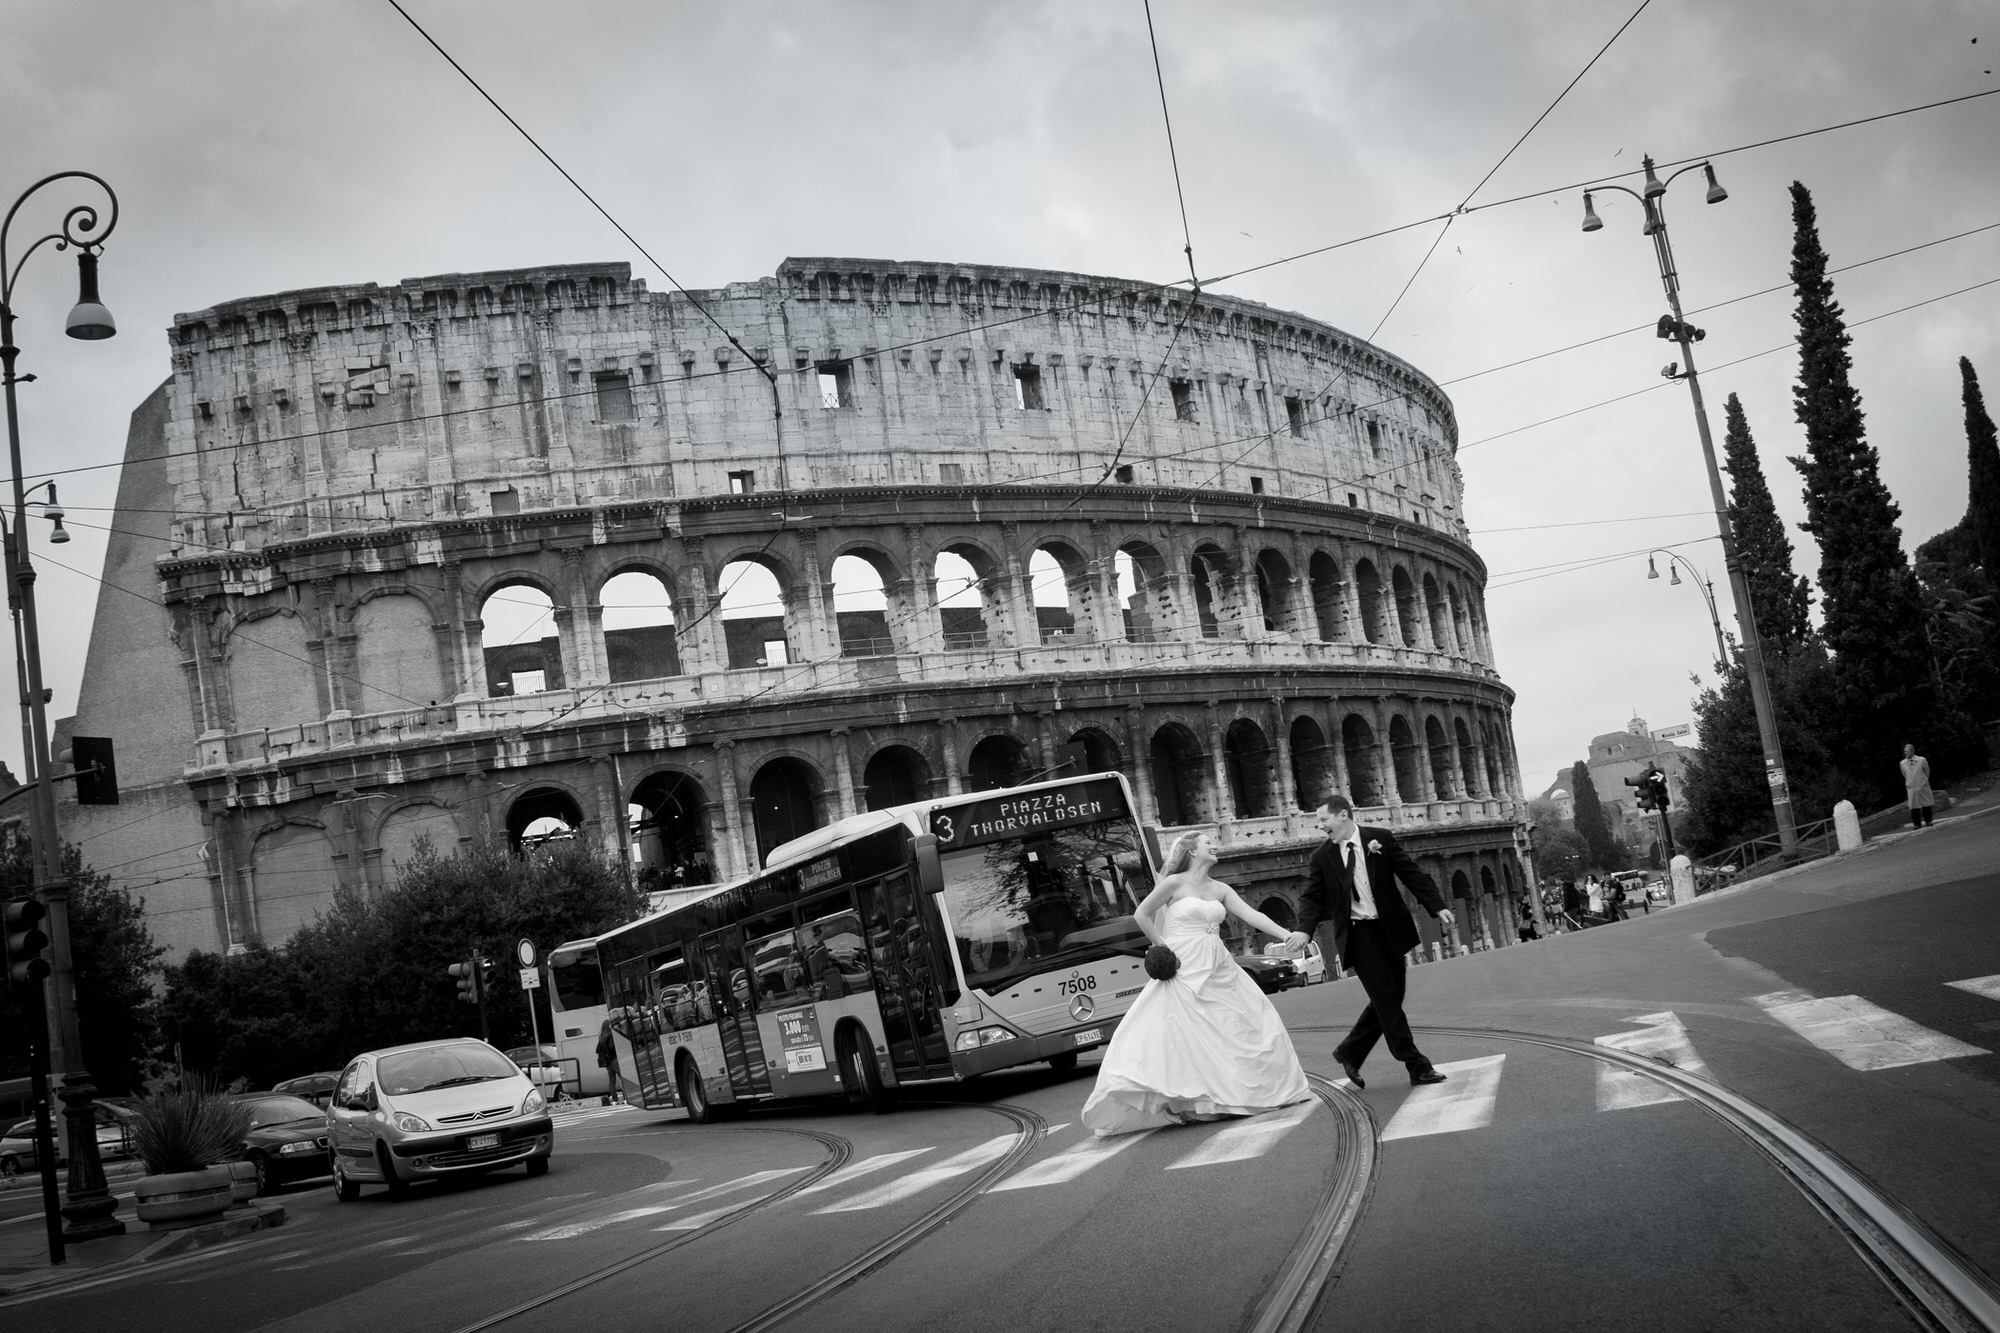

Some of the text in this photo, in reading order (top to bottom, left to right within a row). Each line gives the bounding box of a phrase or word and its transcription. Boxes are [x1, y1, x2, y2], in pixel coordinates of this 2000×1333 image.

[1000, 793, 1066, 817] PIAZZA
[936, 815, 955, 843] 3
[970, 801, 1102, 837] THORVALDSEN
[797, 869, 806, 890] 3
[1057, 975, 1097, 996] 7508
[784, 1020, 802, 1036] 3.000
